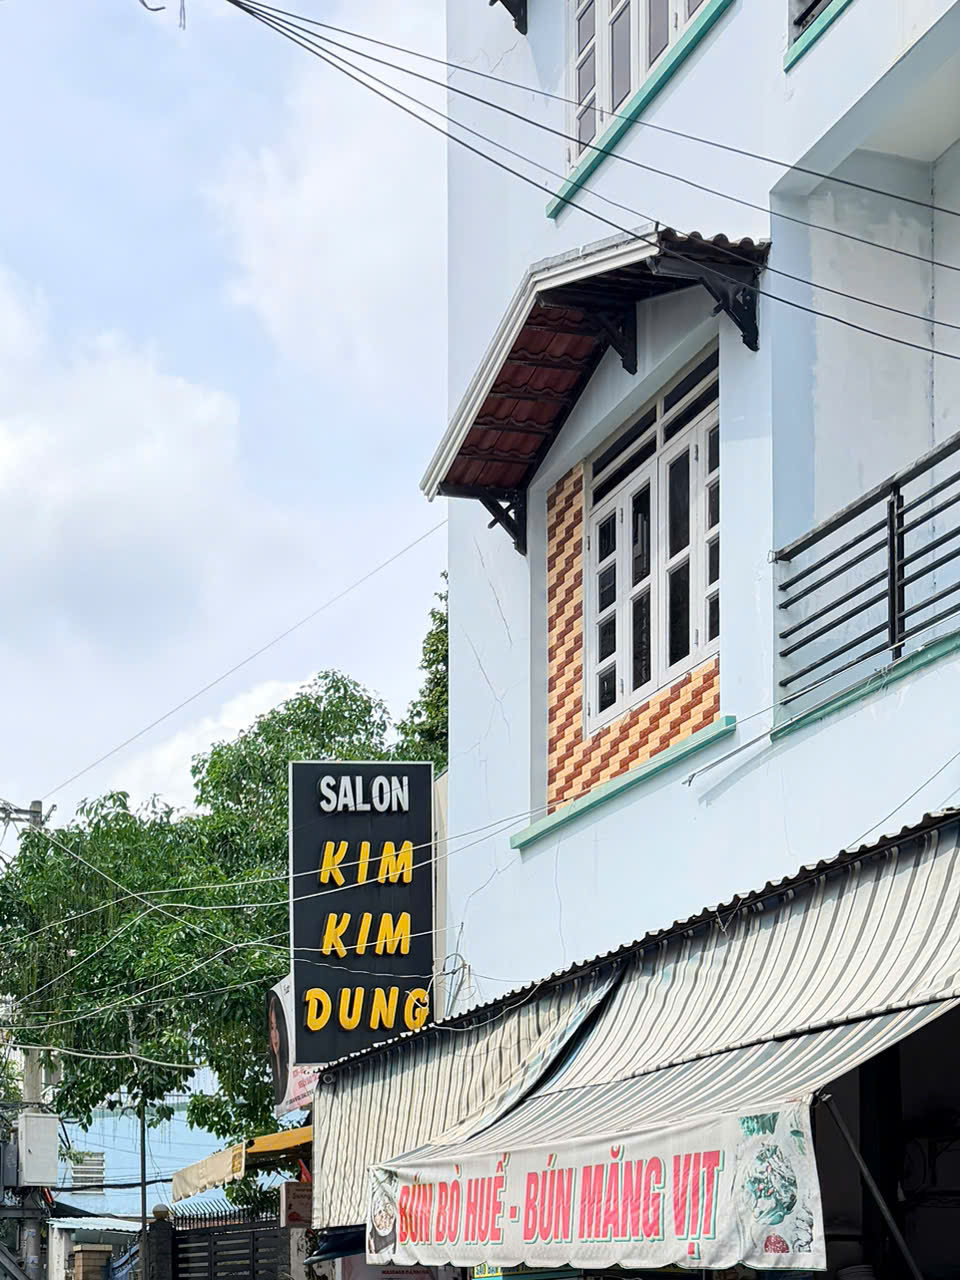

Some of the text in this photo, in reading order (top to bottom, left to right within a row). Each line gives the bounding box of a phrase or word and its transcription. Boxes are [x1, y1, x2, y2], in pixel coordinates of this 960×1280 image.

[319, 775, 410, 812] SALON
[320, 840, 413, 886] KIM
[322, 911, 411, 958] KIM
[305, 986, 430, 1031] DUNG
[398, 1174, 434, 1245] BÚN
[435, 1164, 463, 1245] BÒ
[464, 1152, 512, 1246] HUẾ
[523, 1152, 576, 1244] BÚN
[577, 1144, 667, 1242] MĂNG
[671, 1149, 726, 1261] VỊT
